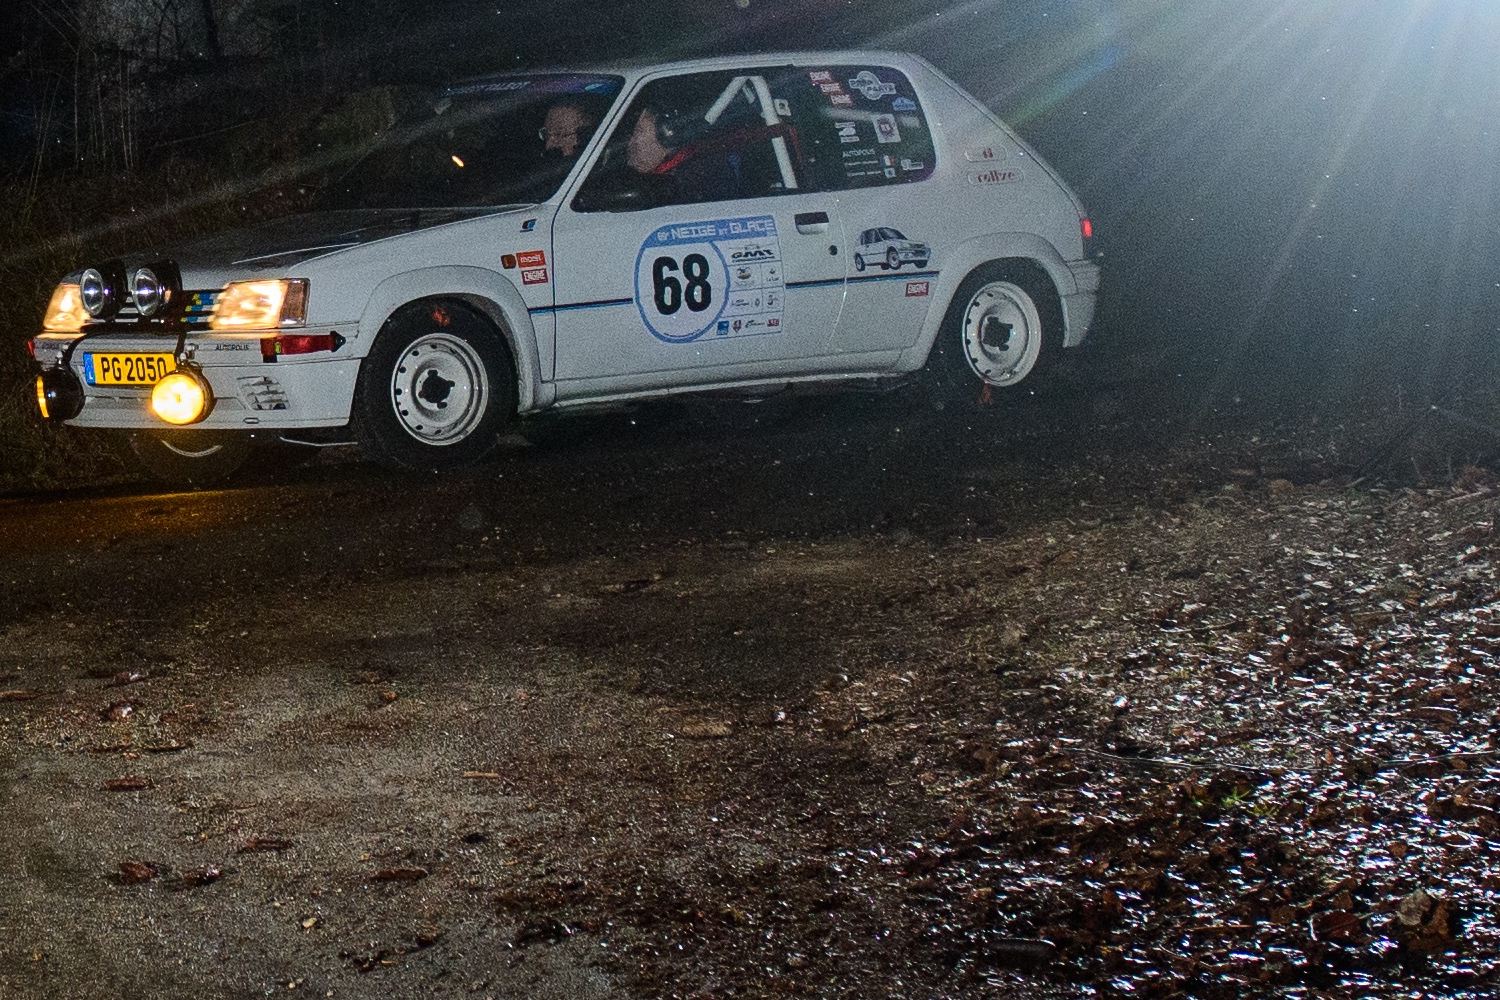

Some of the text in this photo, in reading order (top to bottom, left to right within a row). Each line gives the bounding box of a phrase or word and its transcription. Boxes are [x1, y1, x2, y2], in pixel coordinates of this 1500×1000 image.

[671, 225, 716, 239] NEIGE
[729, 219, 775, 234] GLACE
[652, 253, 712, 315] 68
[215, 343, 249, 351] AUTOPOLIS
[100, 357, 167, 382] PG 2050
